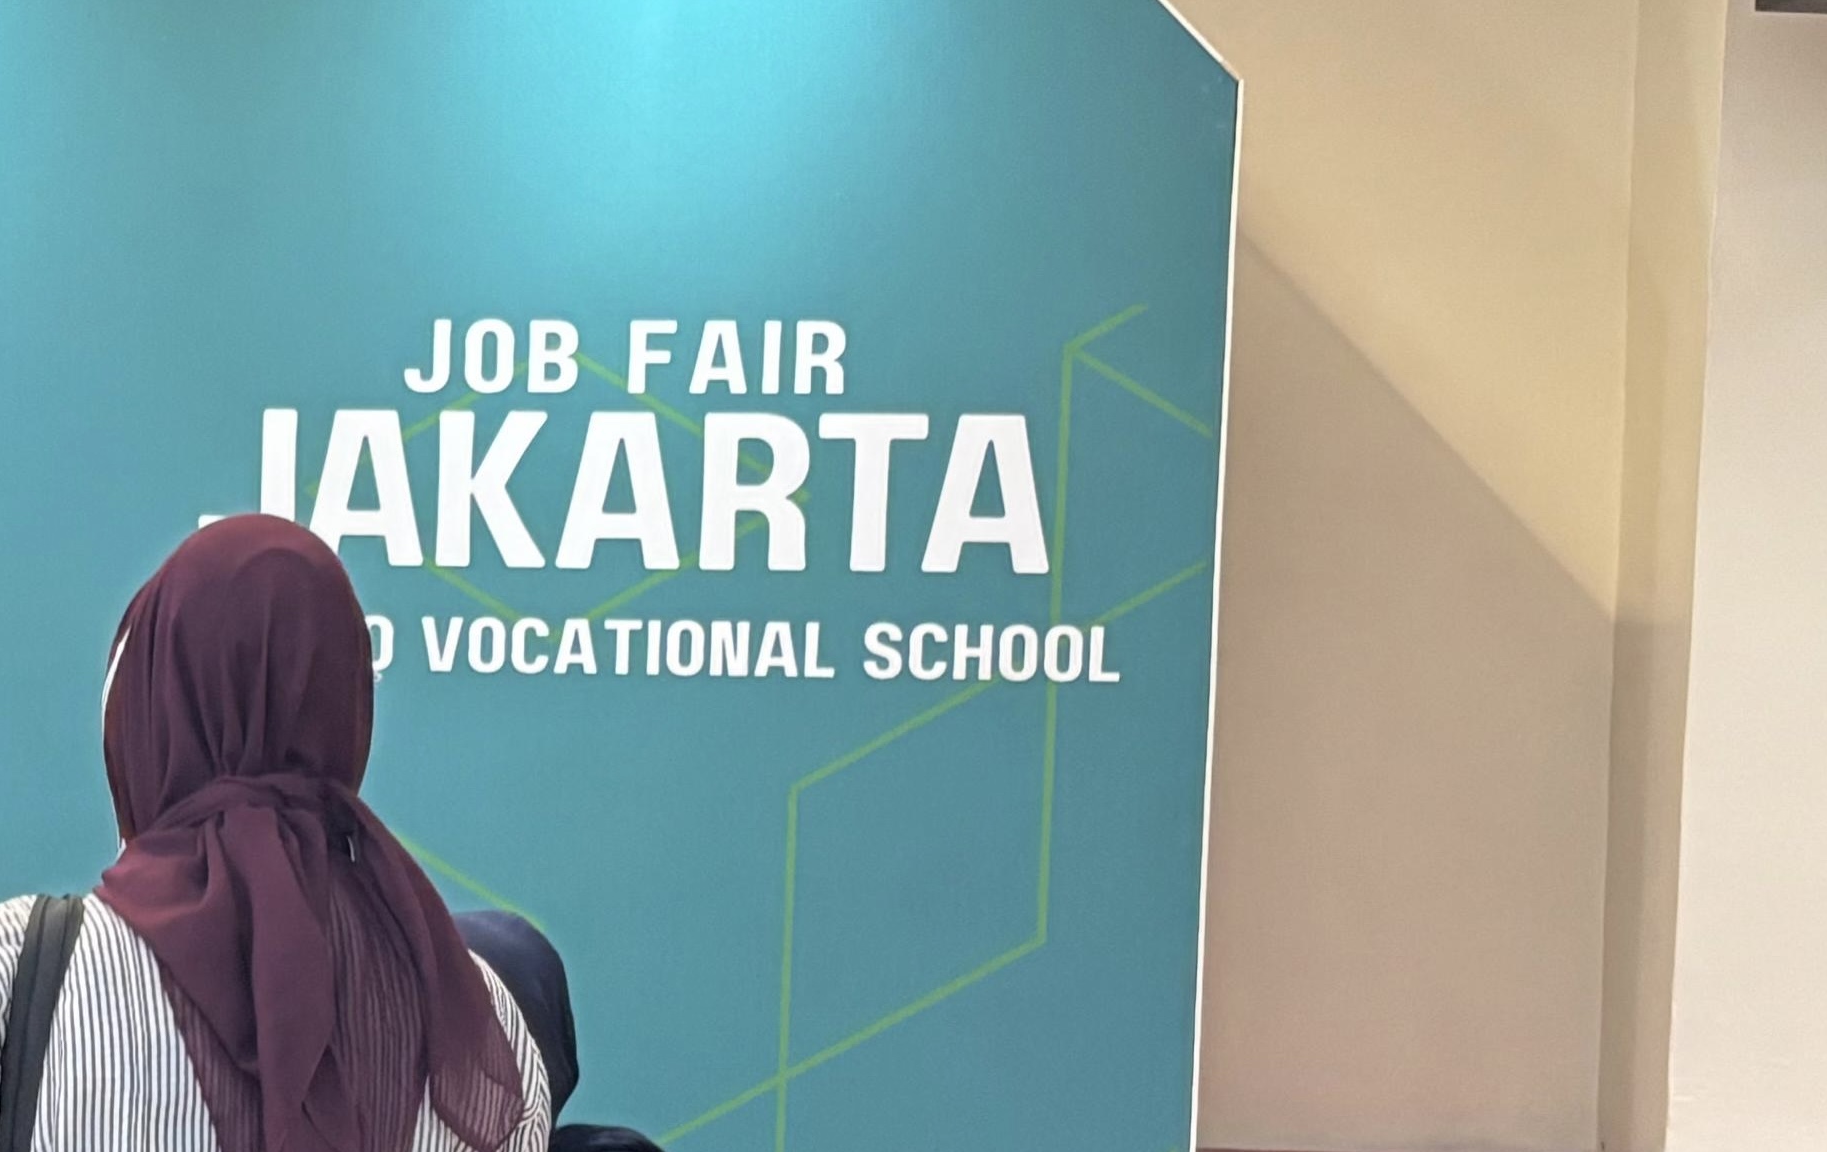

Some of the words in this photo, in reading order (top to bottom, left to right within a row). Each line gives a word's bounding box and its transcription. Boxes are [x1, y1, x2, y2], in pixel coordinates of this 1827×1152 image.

[404, 318, 580, 394] JOB
[627, 319, 848, 396] FAIR
[198, 407, 1050, 575] JAKARTA
[421, 616, 835, 680] VOCATIONAL
[862, 622, 1120, 683] SCHOOL
